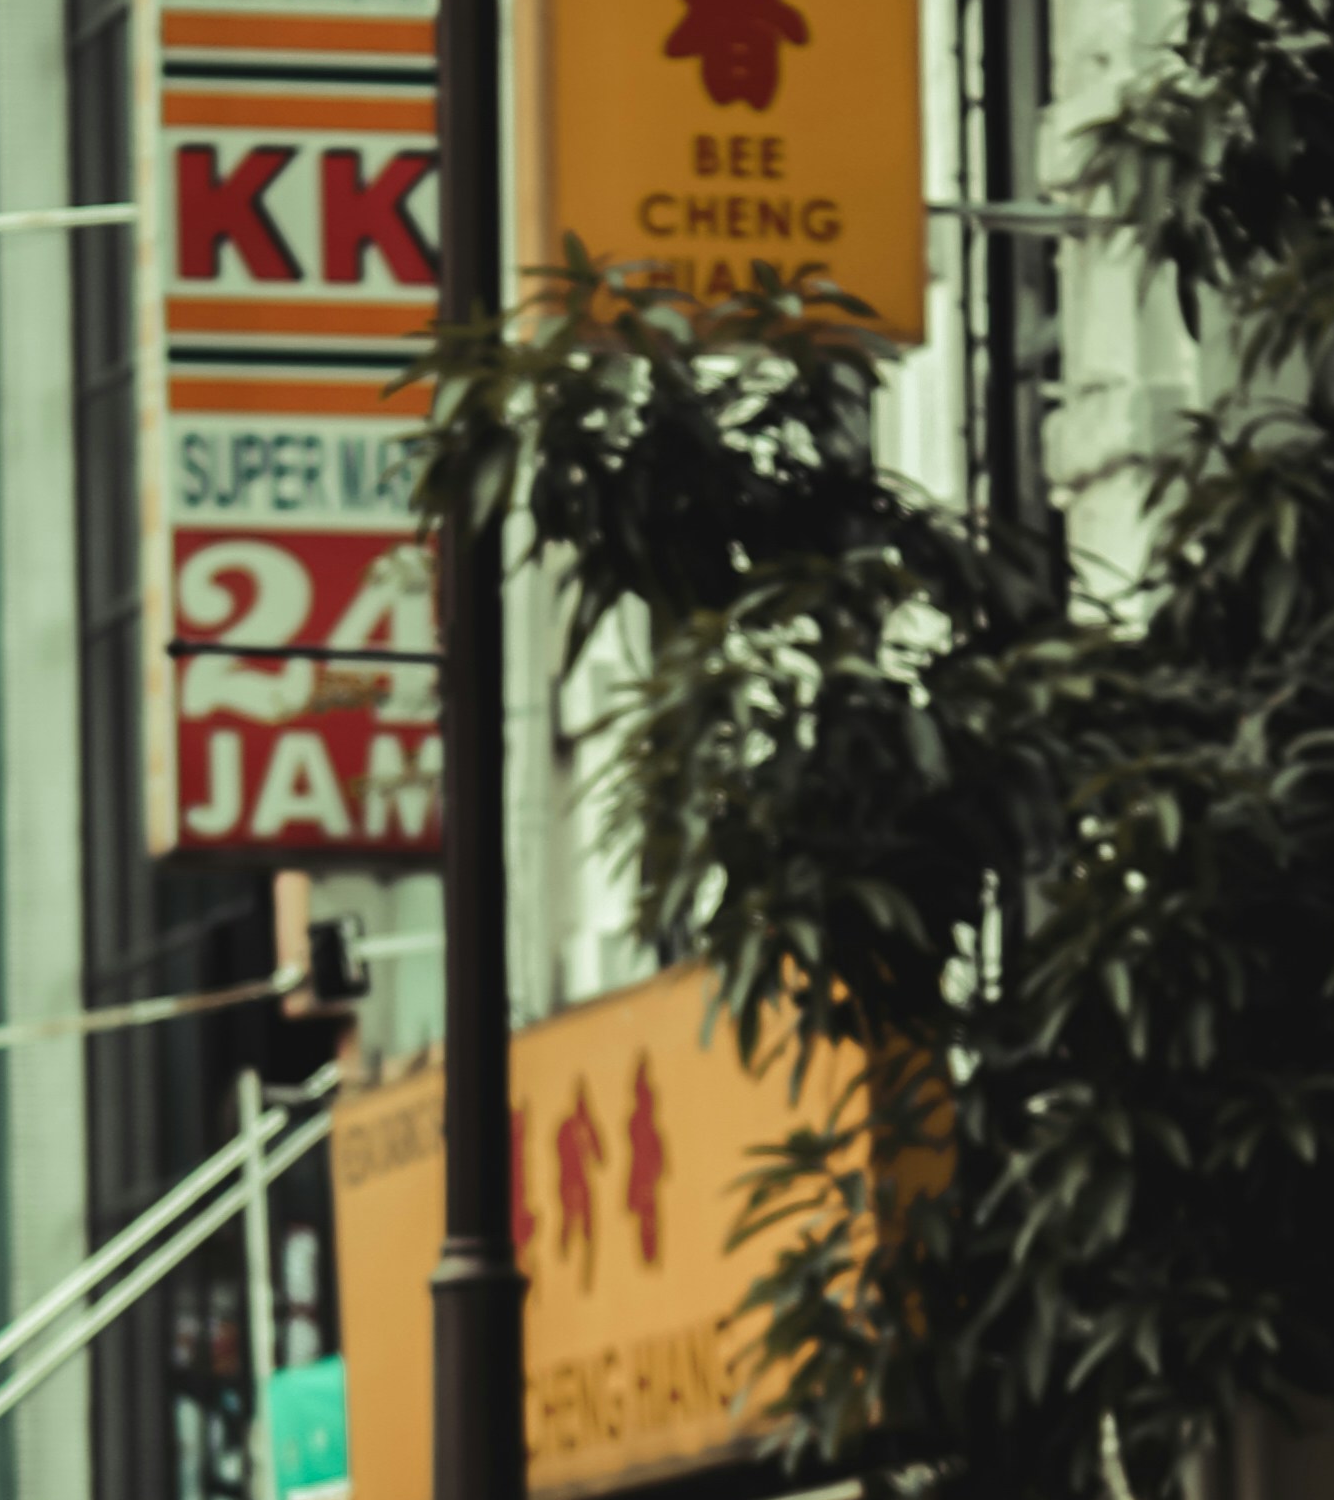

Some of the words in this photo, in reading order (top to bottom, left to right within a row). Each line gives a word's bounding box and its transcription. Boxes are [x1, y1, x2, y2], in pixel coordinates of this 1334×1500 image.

[693, 134, 785, 180] BEE
[176, 143, 441, 286] KK
[637, 192, 842, 243] CHENG
[179, 432, 325, 512] SUPER
[179, 539, 441, 725] 24
[186, 729, 442, 840] JAM
